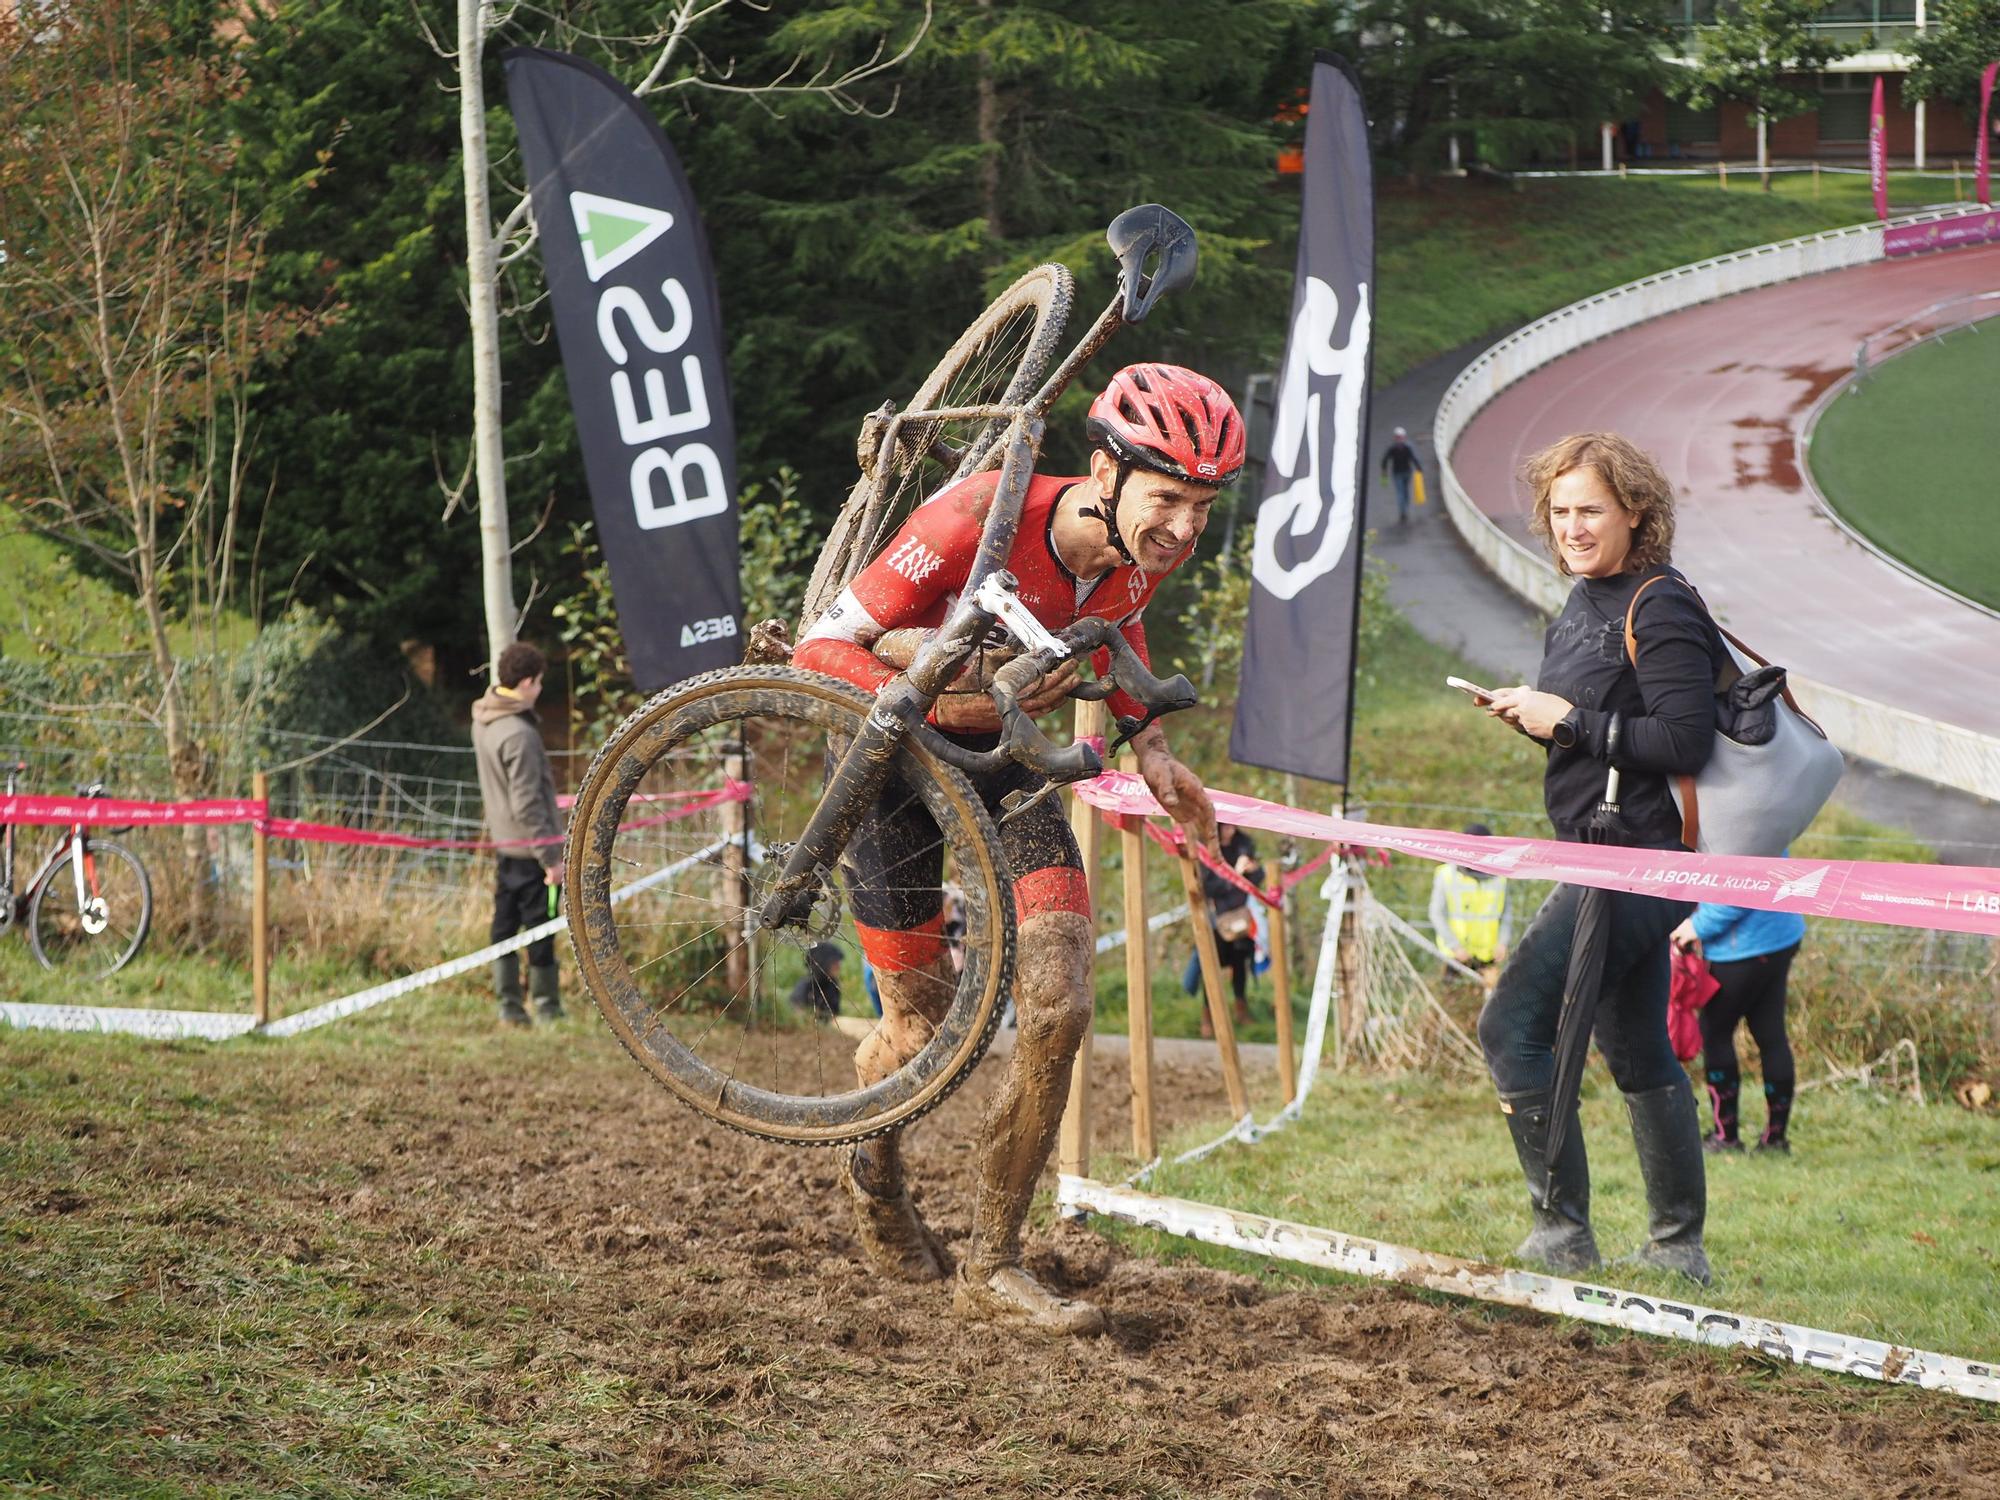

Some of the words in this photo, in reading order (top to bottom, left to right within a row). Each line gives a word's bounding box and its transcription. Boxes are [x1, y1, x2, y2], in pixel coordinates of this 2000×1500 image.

[1197, 463, 1217, 475] GES
[1642, 868, 1719, 887] LABORAL
[1722, 874, 1771, 891] kutxa
